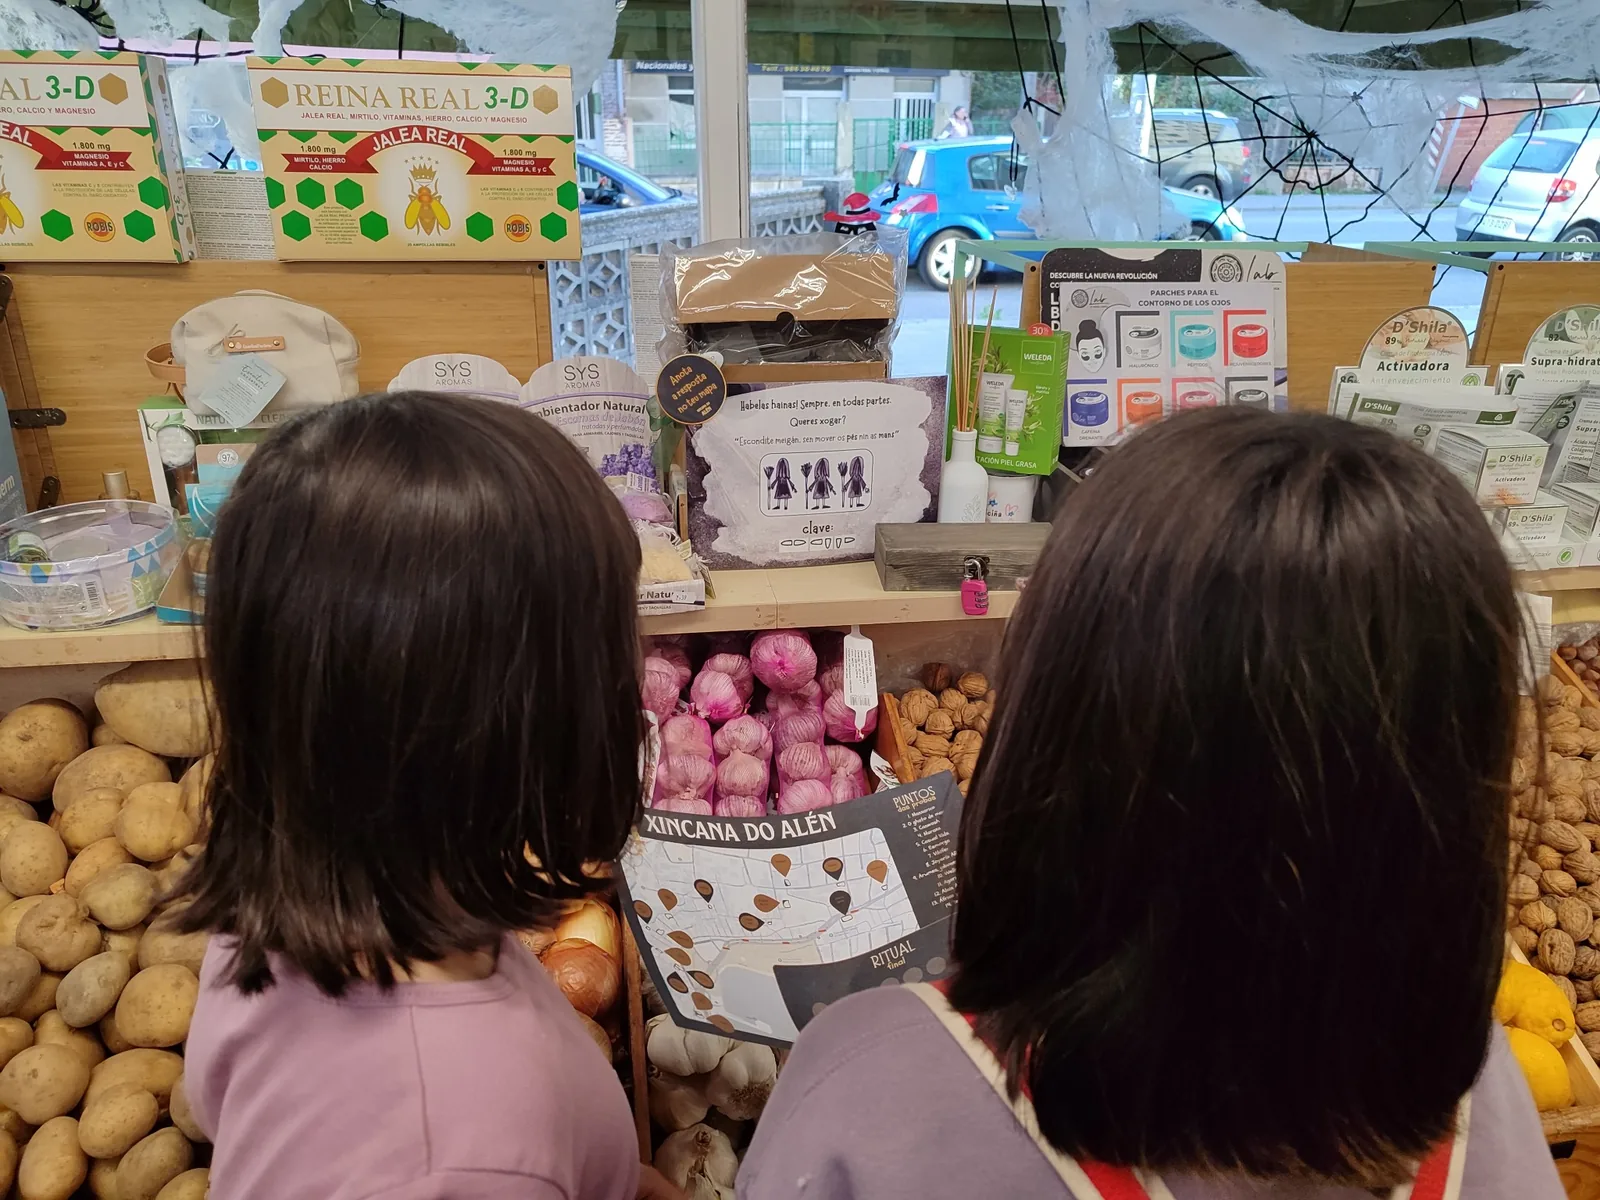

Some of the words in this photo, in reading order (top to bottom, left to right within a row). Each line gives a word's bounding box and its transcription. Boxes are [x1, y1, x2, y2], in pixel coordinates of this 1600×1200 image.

[45, 75, 95, 100] 3-D
[292, 83, 393, 109] REINA
[398, 87, 480, 110] REAL
[484, 86, 529, 110] 3-D
[55, 107, 96, 115] MAGNESIO
[326, 112, 349, 120] REAL,
[350, 113, 381, 121] MIRTILO,
[383, 114, 424, 122] VITAMINAS,
[425, 115, 455, 123] HIERRO,
[490, 116, 528, 124] MAGNESIO
[72, 142, 95, 150] 1.800
[372, 126, 422, 152] JALEA
[426, 127, 468, 154] REAL
[300, 145, 322, 153] 1.800
[323, 146, 337, 154] mg
[525, 150, 537, 158] mg
[62, 160, 98, 168] VITAMINAS
[293, 156, 321, 164] MIRTILO,
[87, 221, 114, 232] ROBIS
[506, 223, 530, 233] ROBIS
[1094, 272, 1116, 280] NUEVA
[1116, 271, 1158, 280] REVOLUCIÓN
[1023, 353, 1052, 362] WELEDA
[1376, 360, 1450, 372] Activadora
[436, 378, 472, 386] AROMAS
[669, 366, 693, 386] Anota
[565, 380, 601, 390] AROMAS
[676, 373, 708, 397] resposta
[678, 404, 688, 414] no
[686, 396, 700, 406] teu
[698, 383, 718, 398] mapa
[740, 400, 770, 412] Habelas
[771, 399, 798, 410] hainas!
[842, 396, 865, 406] todas
[866, 396, 892, 408] partes.
[534, 400, 600, 418] mbientador
[603, 400, 646, 414] Natural
[1364, 401, 1392, 412] D'Shila
[557, 414, 600, 426] Escamas
[789, 416, 818, 428] Queres
[820, 415, 847, 427] xogar?
[802, 436, 814, 444] sen
[1015, 460, 1037, 469] GRASA
[802, 520, 834, 534] clave:
[892, 785, 936, 808] PUNTOS
[897, 804, 910, 813] das
[912, 796, 937, 810] probas
[644, 814, 740, 842] XINCANA
[743, 822, 775, 842] DO
[781, 811, 837, 840] ALÉN
[870, 940, 916, 968] RITUAL
[887, 956, 906, 970] final
